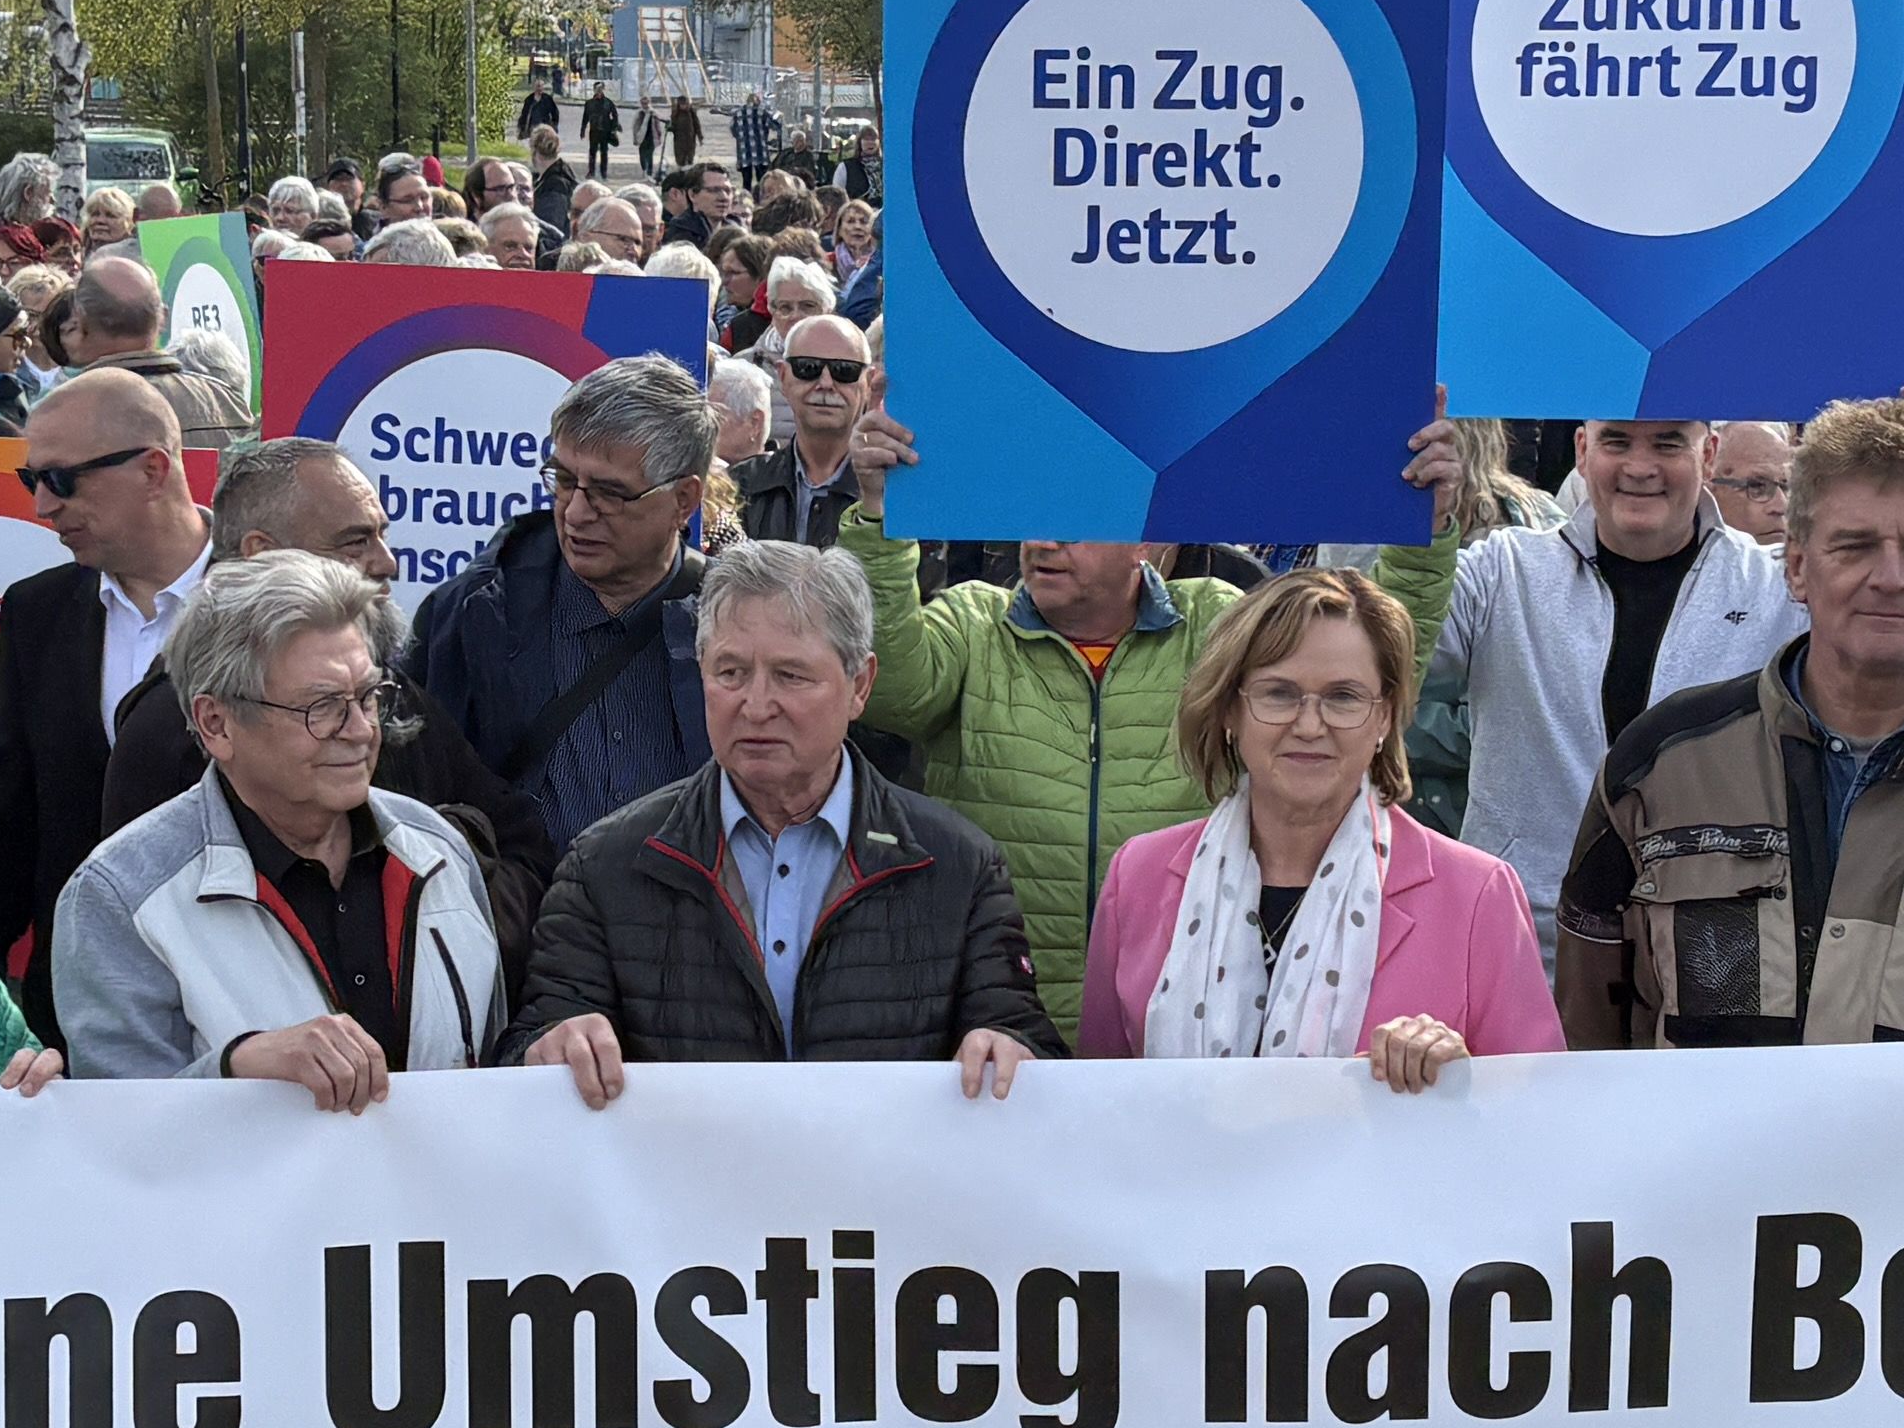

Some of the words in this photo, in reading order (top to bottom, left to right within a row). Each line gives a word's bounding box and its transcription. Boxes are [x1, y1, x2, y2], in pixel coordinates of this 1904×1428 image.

[1033, 46, 1135, 110] Ein
[1154, 50, 1305, 129] Zug.
[1516, 40, 1682, 97] fährt
[1695, 43, 1818, 114] Zug
[1053, 125, 1281, 189] Direkt.
[1071, 205, 1256, 265] Jetzt.
[1205, 1221, 1673, 1424] nach
